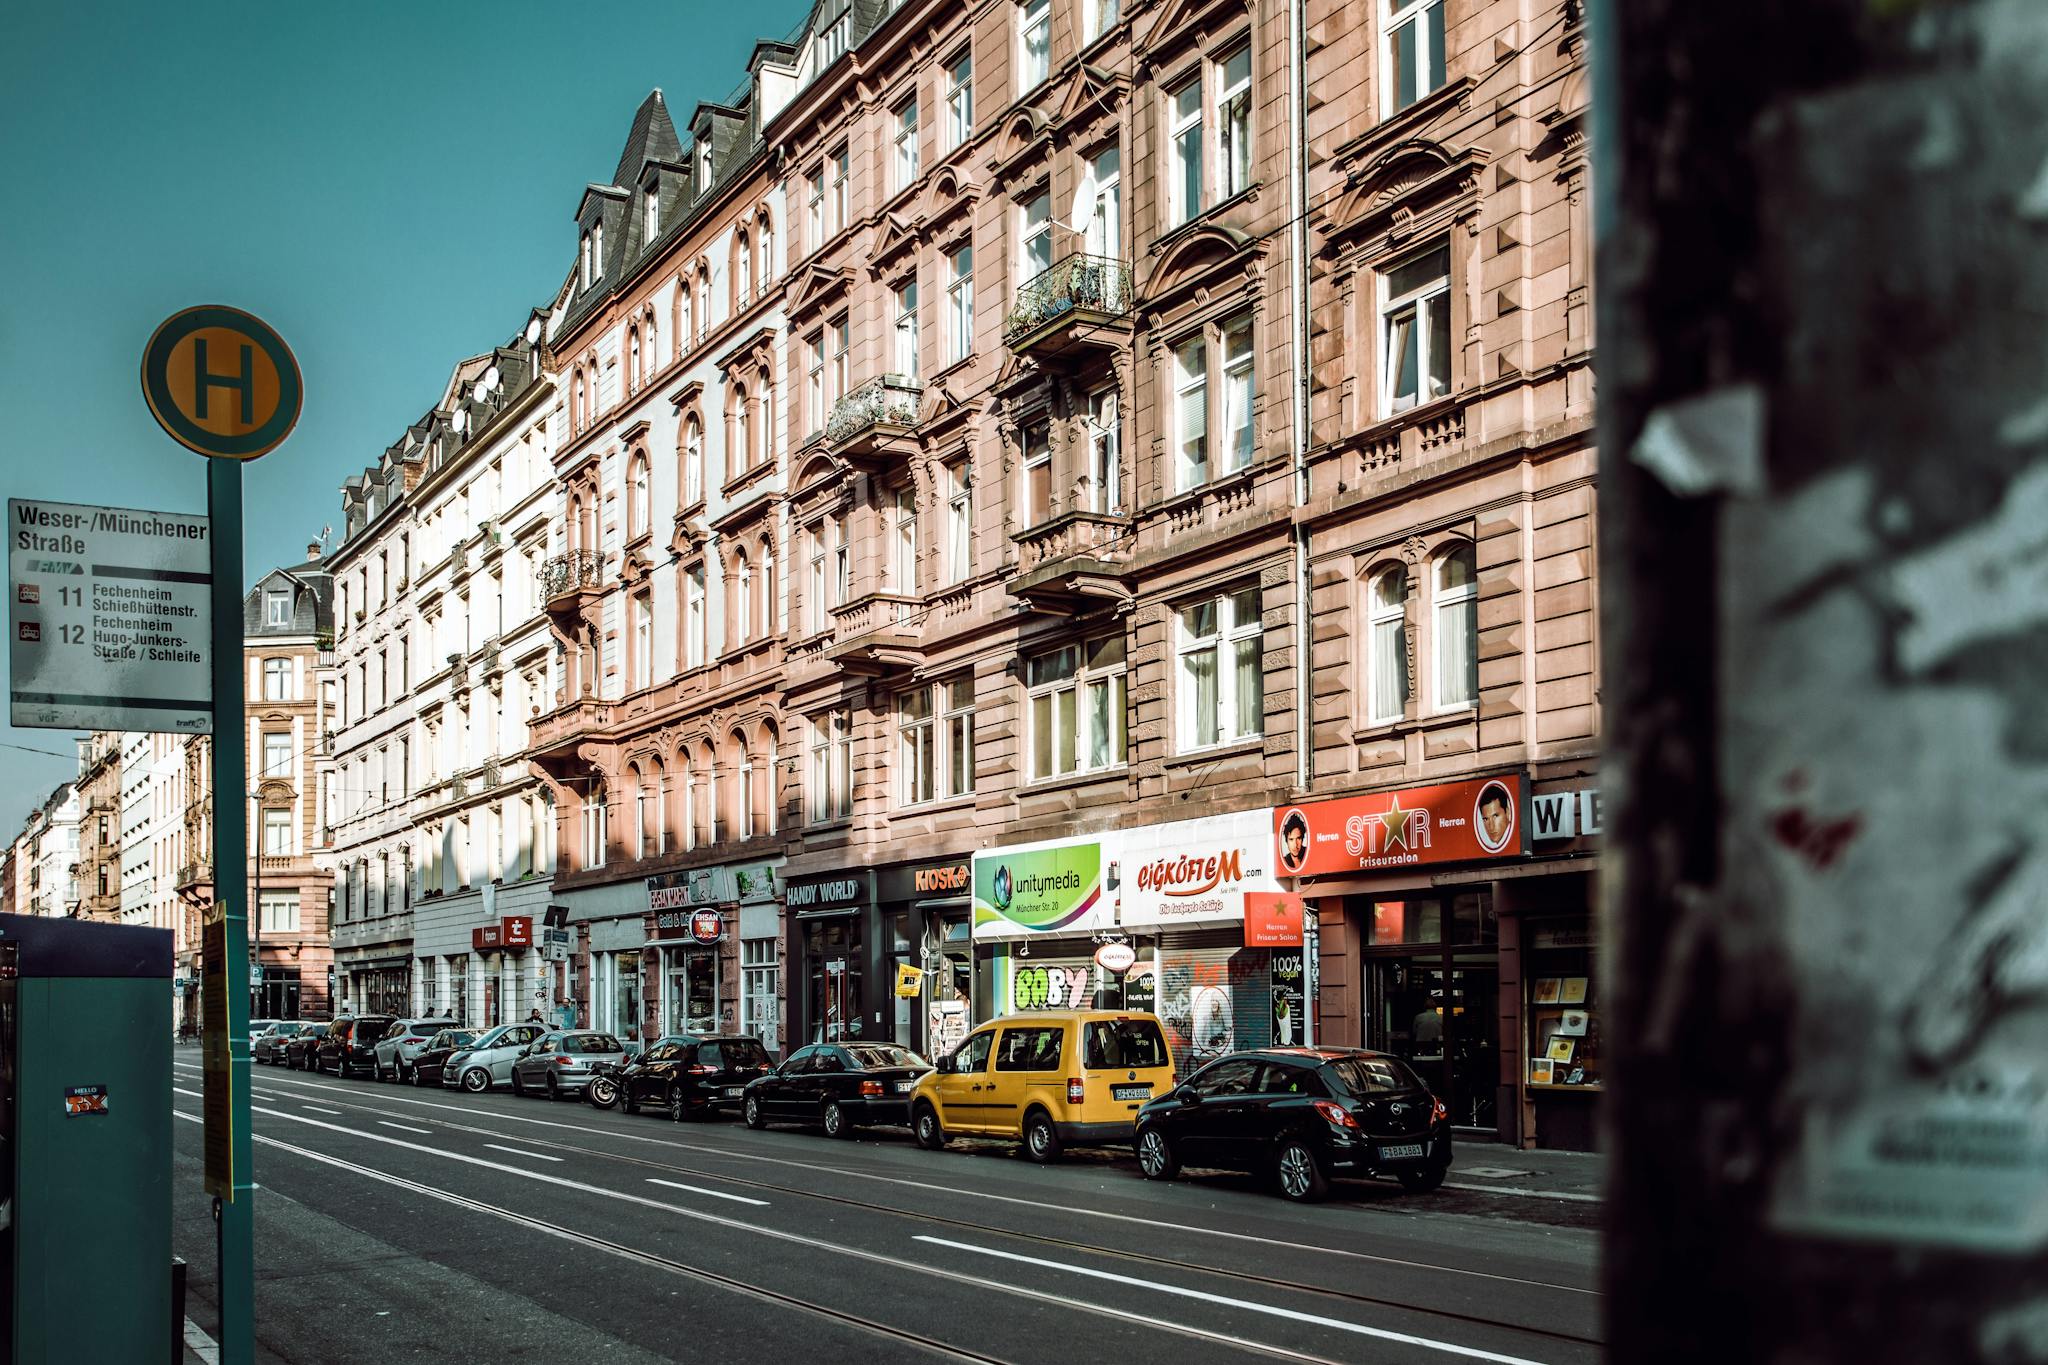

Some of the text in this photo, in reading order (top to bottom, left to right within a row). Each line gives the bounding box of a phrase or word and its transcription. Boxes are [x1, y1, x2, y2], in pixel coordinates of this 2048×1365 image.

[194, 337, 254, 425] H
[17, 505, 207, 540] Weser-/Münchener
[18, 531, 85, 554] Straße
[58, 586, 82, 607] 11
[93, 583, 172, 601] Fechenheim
[93, 598, 198, 618] Schießhüttenstr.
[93, 615, 173, 632] Fechenheim
[58, 624, 85, 645] 12
[94, 629, 188, 647] Hugo-Junkers-
[94, 645, 136, 660] Straße
[149, 649, 201, 663] Schleife
[1439, 817, 1465, 828] Herren
[1316, 832, 1339, 842] Herren
[1359, 852, 1418, 867] Friseursalon
[915, 867, 956, 891] KIOSK
[1243, 868, 1262, 878] .com
[1016, 870, 1080, 897] unitymedia
[787, 881, 857, 906] HANDY WORLD
[1016, 901, 1059, 913] Münchner Str. 20
[1266, 923, 1288, 931] Herren
[1256, 933, 1298, 941] Friseur Salon
[1272, 956, 1302, 972] 100%
[1279, 970, 1299, 981] vegan
[1015, 966, 1088, 1009] BABY
